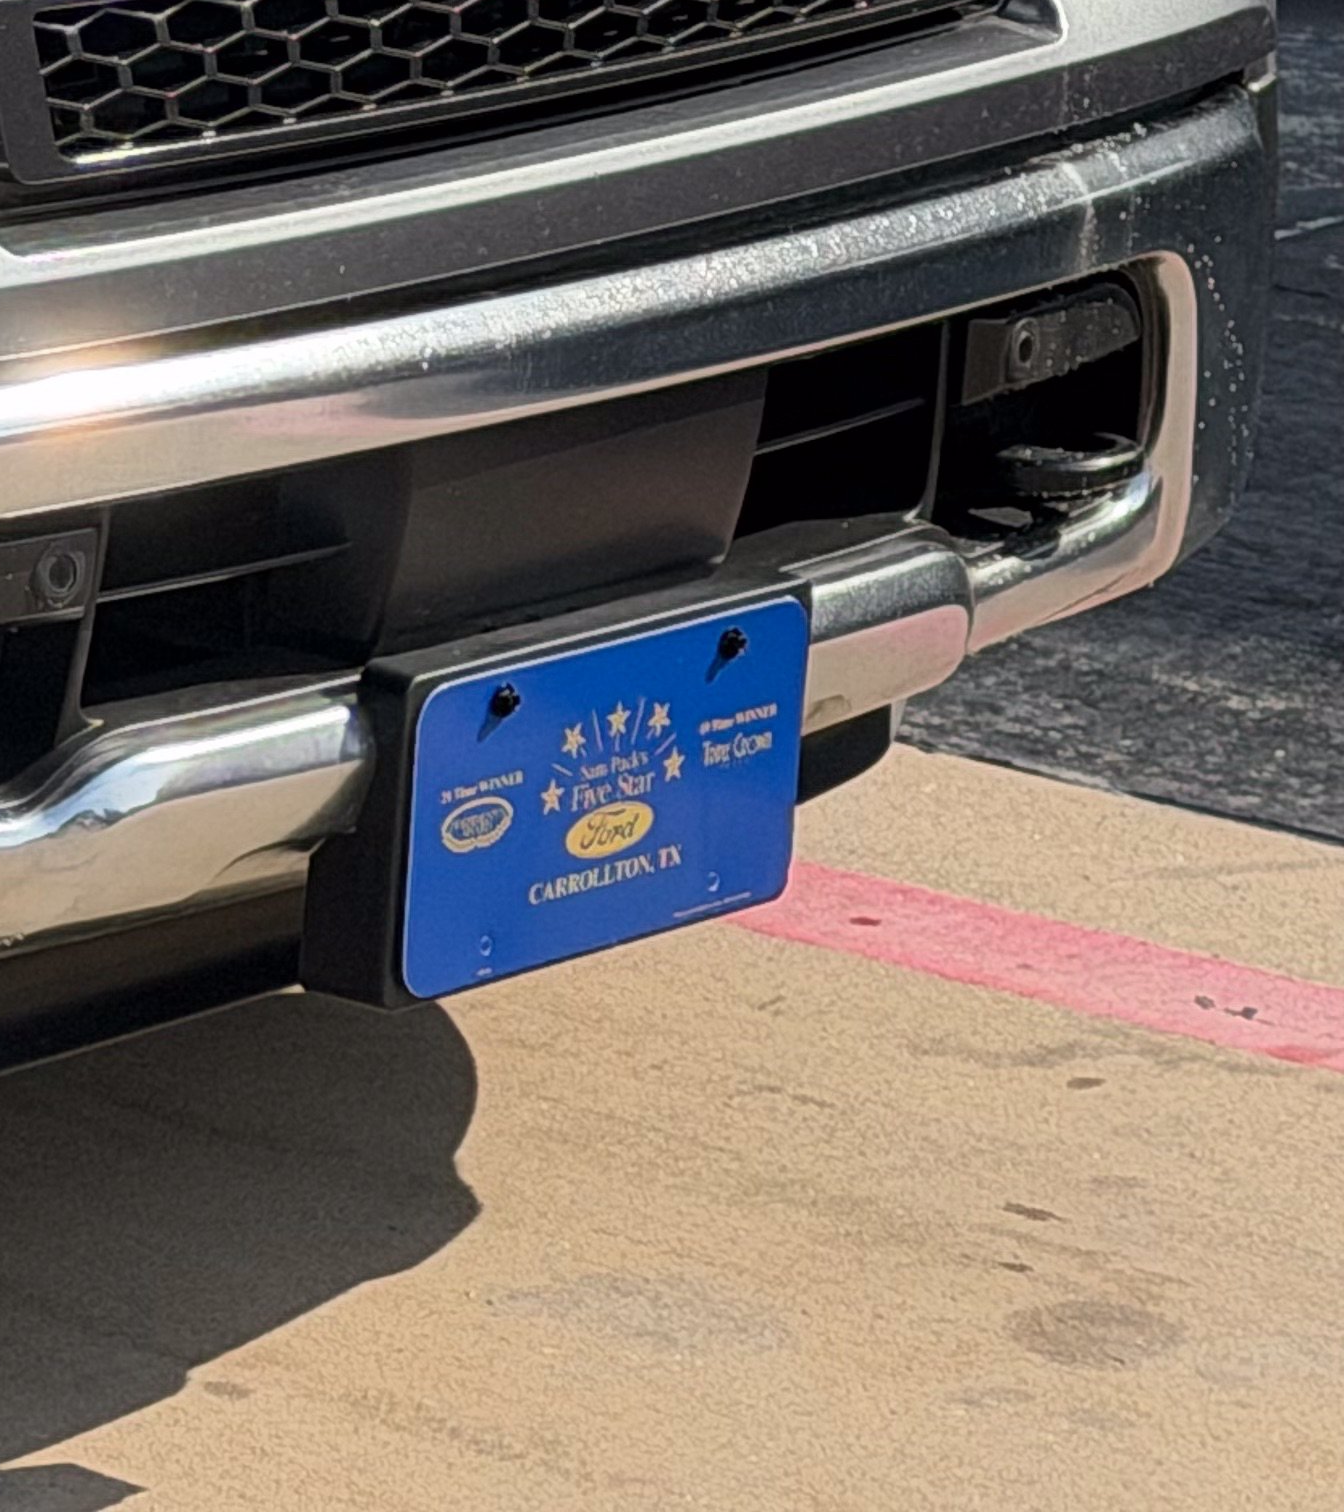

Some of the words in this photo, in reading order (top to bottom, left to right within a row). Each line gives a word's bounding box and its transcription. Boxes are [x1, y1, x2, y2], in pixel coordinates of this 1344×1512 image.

[735, 701, 778, 724] WINNER
[478, 769, 524, 792] WINNER
[570, 781, 613, 812] Five
[616, 770, 657, 798] Star
[579, 807, 641, 851] Ford
[527, 851, 657, 906] CARROLLTON,
[657, 843, 683, 871] TX
